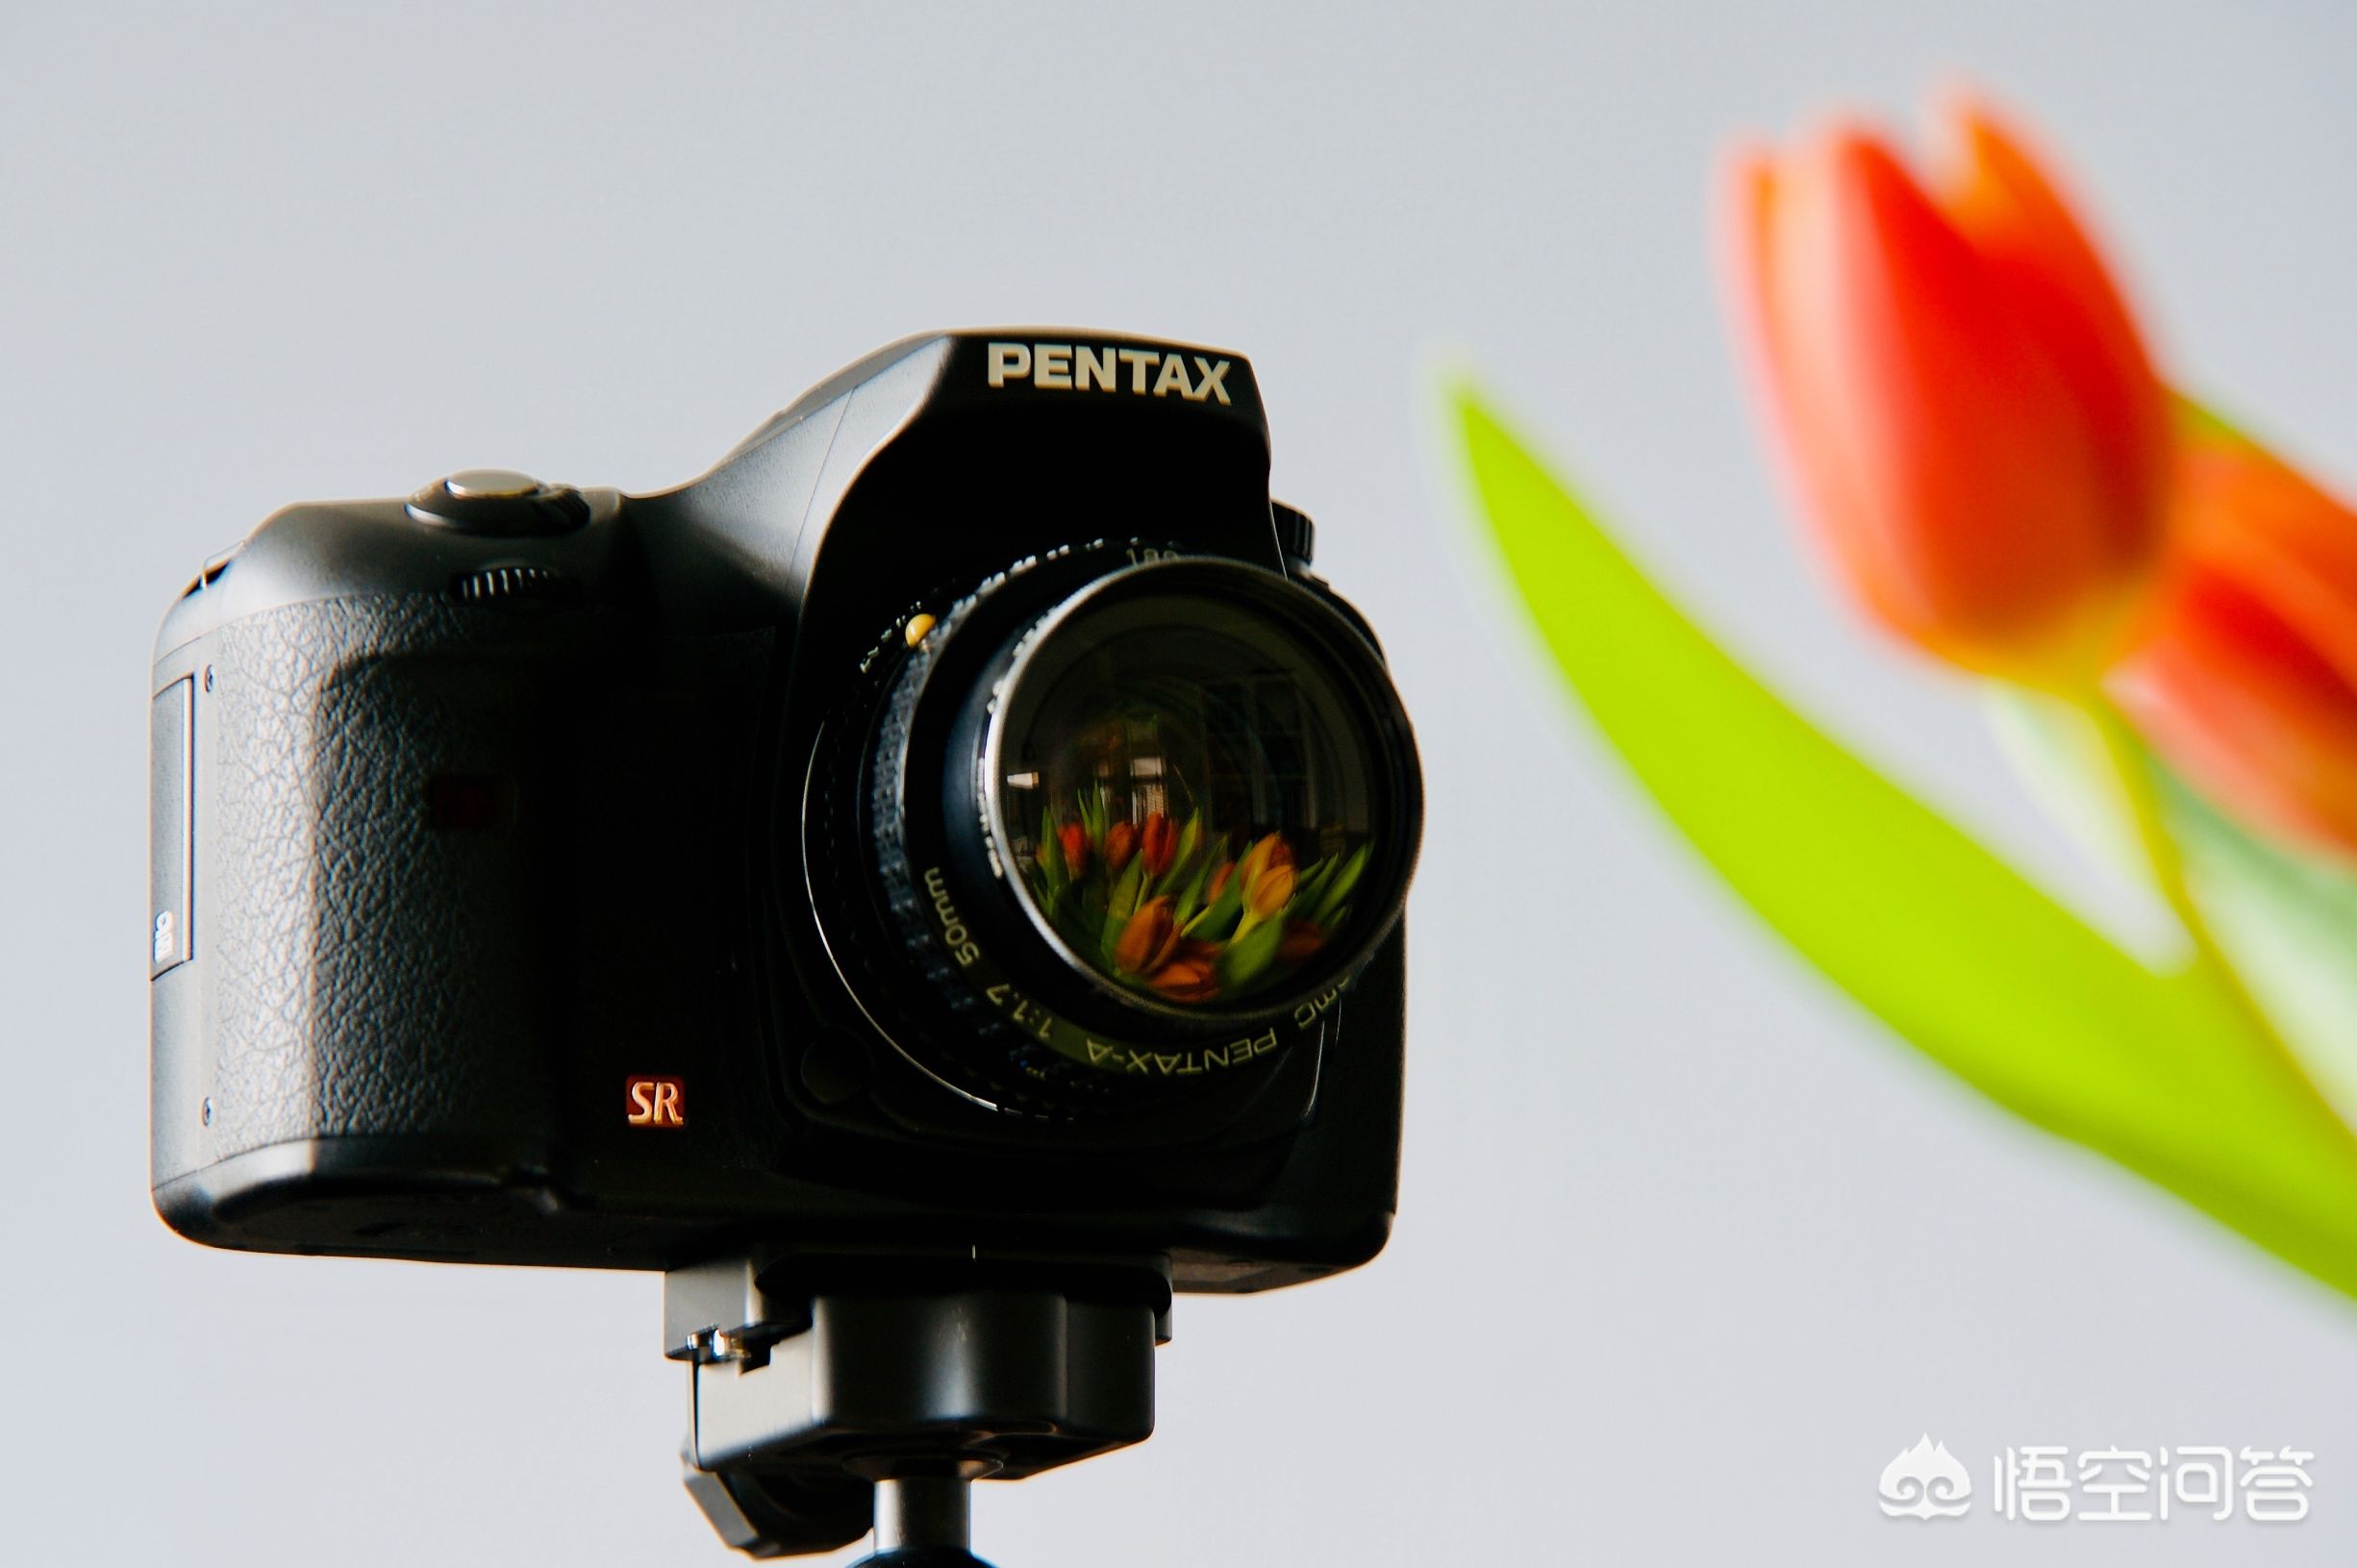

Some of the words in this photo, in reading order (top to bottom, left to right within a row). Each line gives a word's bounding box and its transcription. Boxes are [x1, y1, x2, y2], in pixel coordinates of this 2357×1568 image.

[987, 340, 1232, 407] PENTAX
[923, 866, 981, 968] 50mm
[986, 983, 1053, 1040] 1:1.7
[1086, 1027, 1278, 1076] PENTAX-A
[628, 1082, 685, 1126] SR
